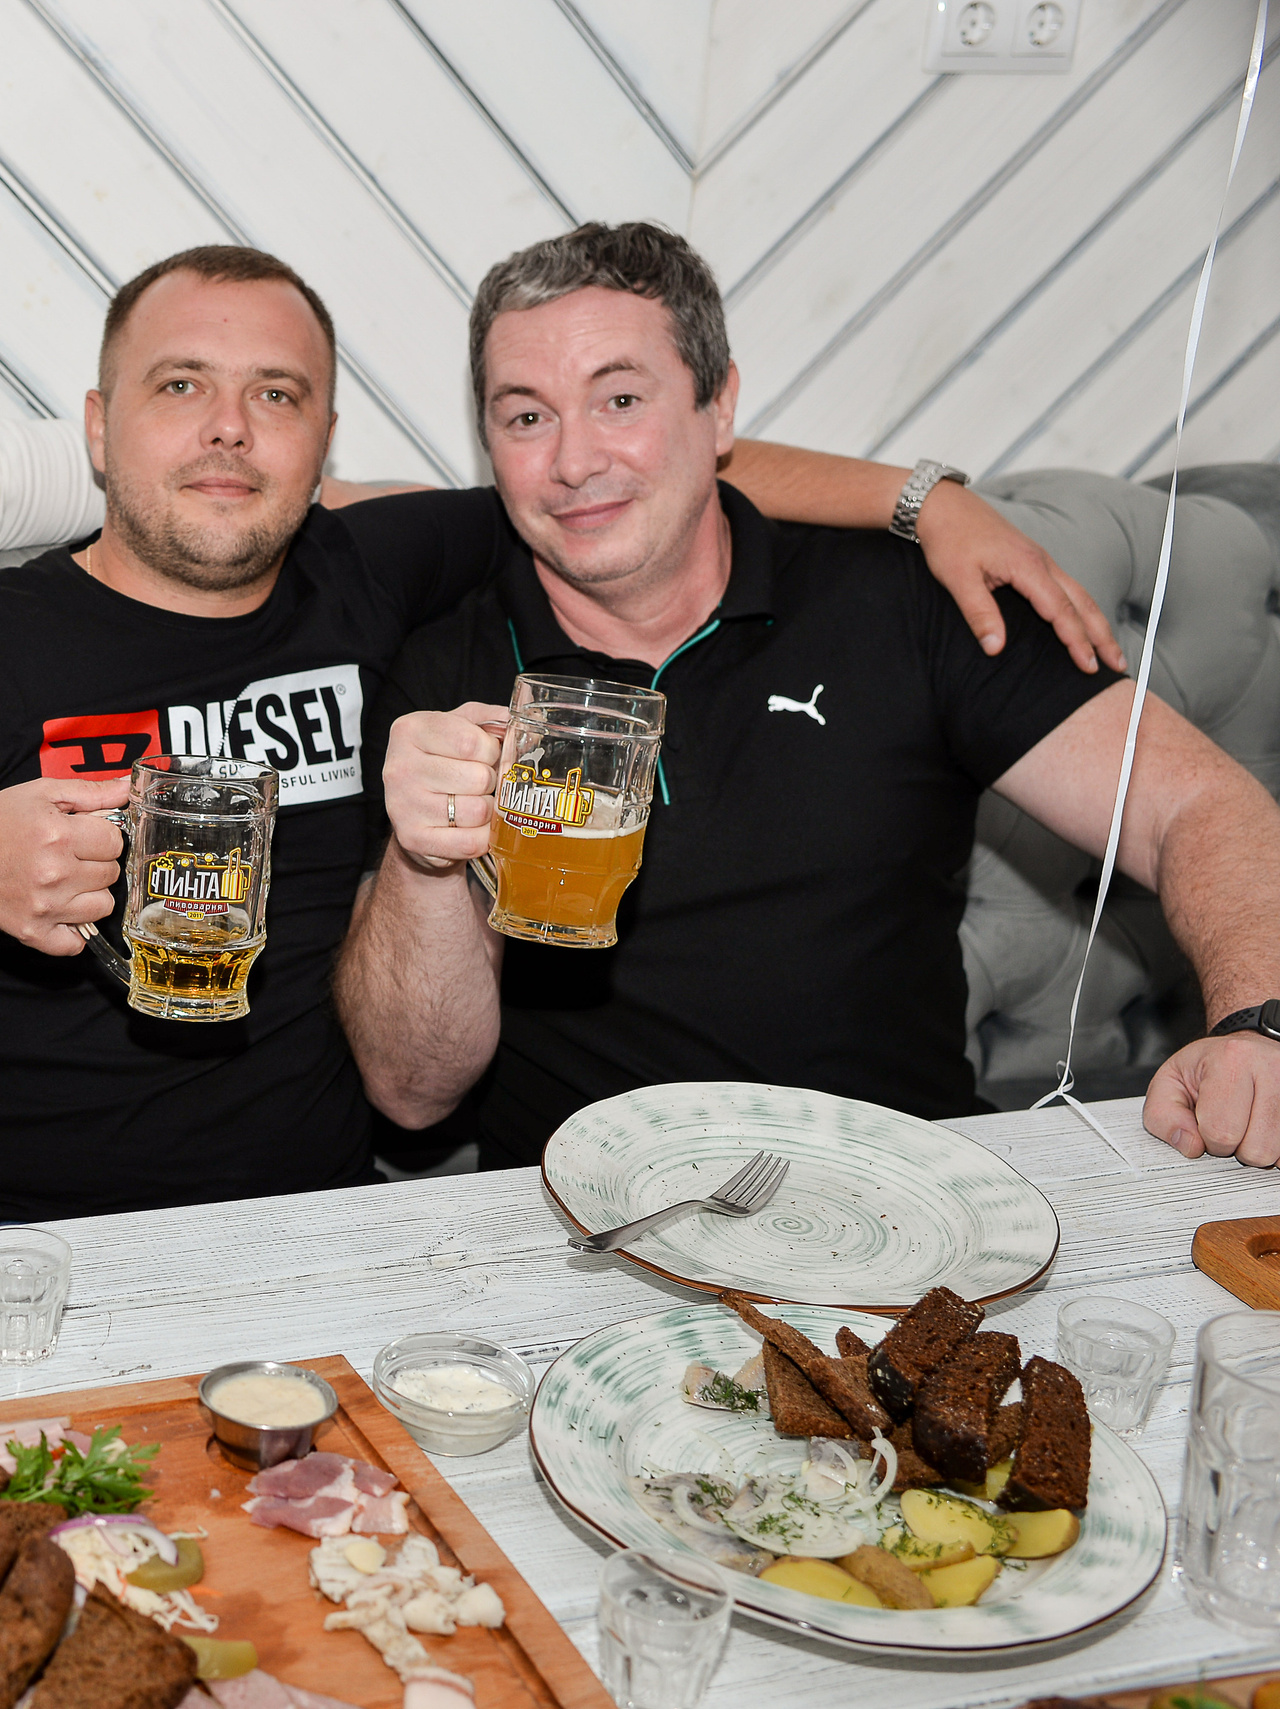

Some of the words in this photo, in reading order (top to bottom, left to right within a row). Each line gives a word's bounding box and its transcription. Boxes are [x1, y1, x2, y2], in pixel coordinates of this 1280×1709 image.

[168, 685, 355, 772] DIESEL
[321, 766, 356, 783] LIVING
[500, 779, 557, 819] ПИНТА
[508, 814, 557, 831] пивоварня
[523, 827, 536, 836] 2011
[151, 866, 220, 900] ПИНТА
[169, 901, 223, 912] пивоварня
